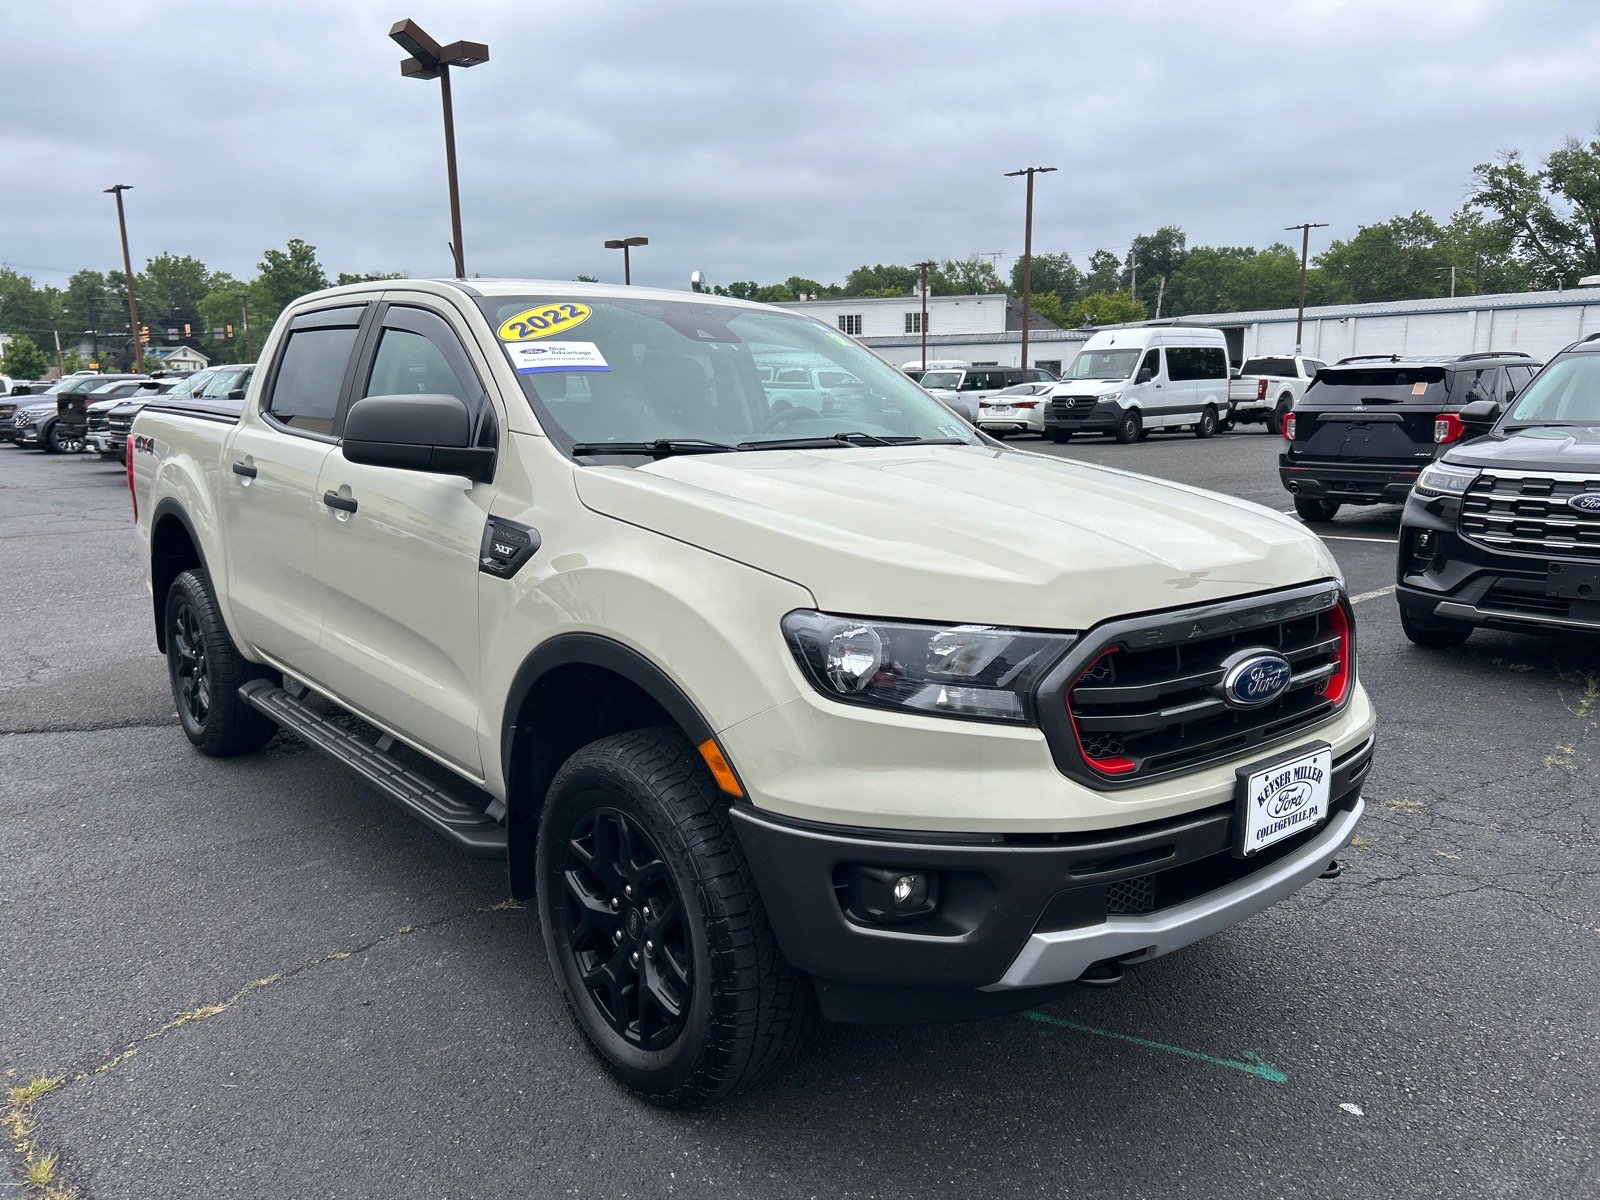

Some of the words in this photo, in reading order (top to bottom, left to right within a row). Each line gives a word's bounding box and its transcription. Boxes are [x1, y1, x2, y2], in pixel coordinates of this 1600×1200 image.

[508, 304, 586, 338] 2022
[1580, 496, 1600, 508] For
[494, 543, 513, 555] XLT
[1247, 665, 1282, 696] Ford
[1257, 770, 1291, 808] KEYSER
[1293, 766, 1323, 785] MILLER
[1274, 786, 1306, 815] Ford
